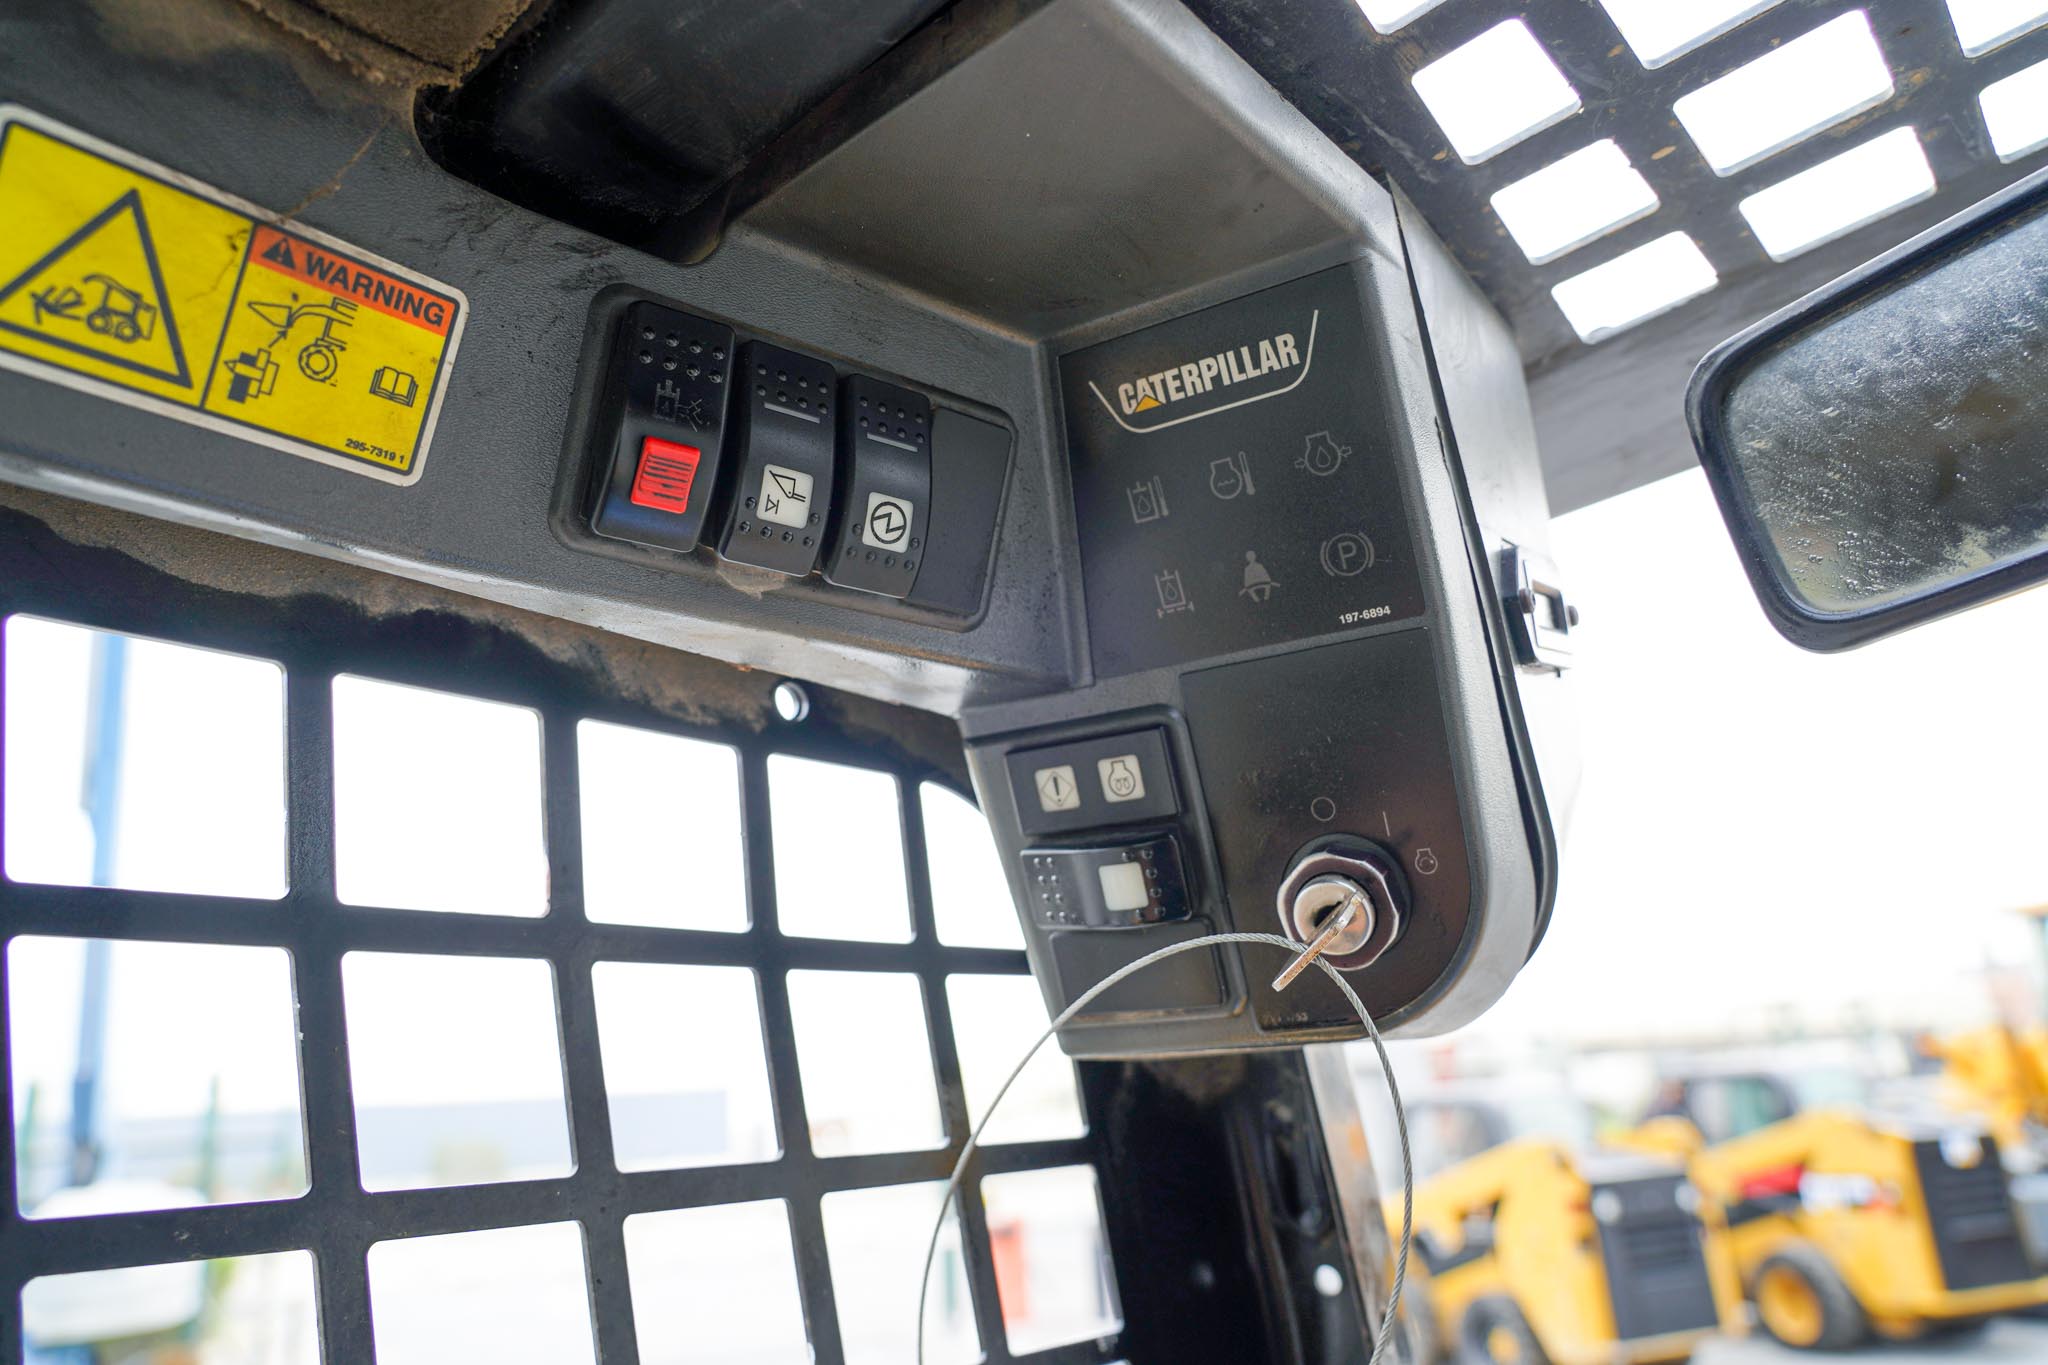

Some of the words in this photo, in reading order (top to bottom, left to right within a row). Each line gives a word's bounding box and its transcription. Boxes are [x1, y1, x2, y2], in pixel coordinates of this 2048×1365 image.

[305, 252, 445, 327] WARNING
[1118, 333, 1301, 415] CATERPILLAR
[345, 438, 396, 462] 295-7319
[1337, 541, 1357, 570] P
[1339, 605, 1391, 624] 197-6894
